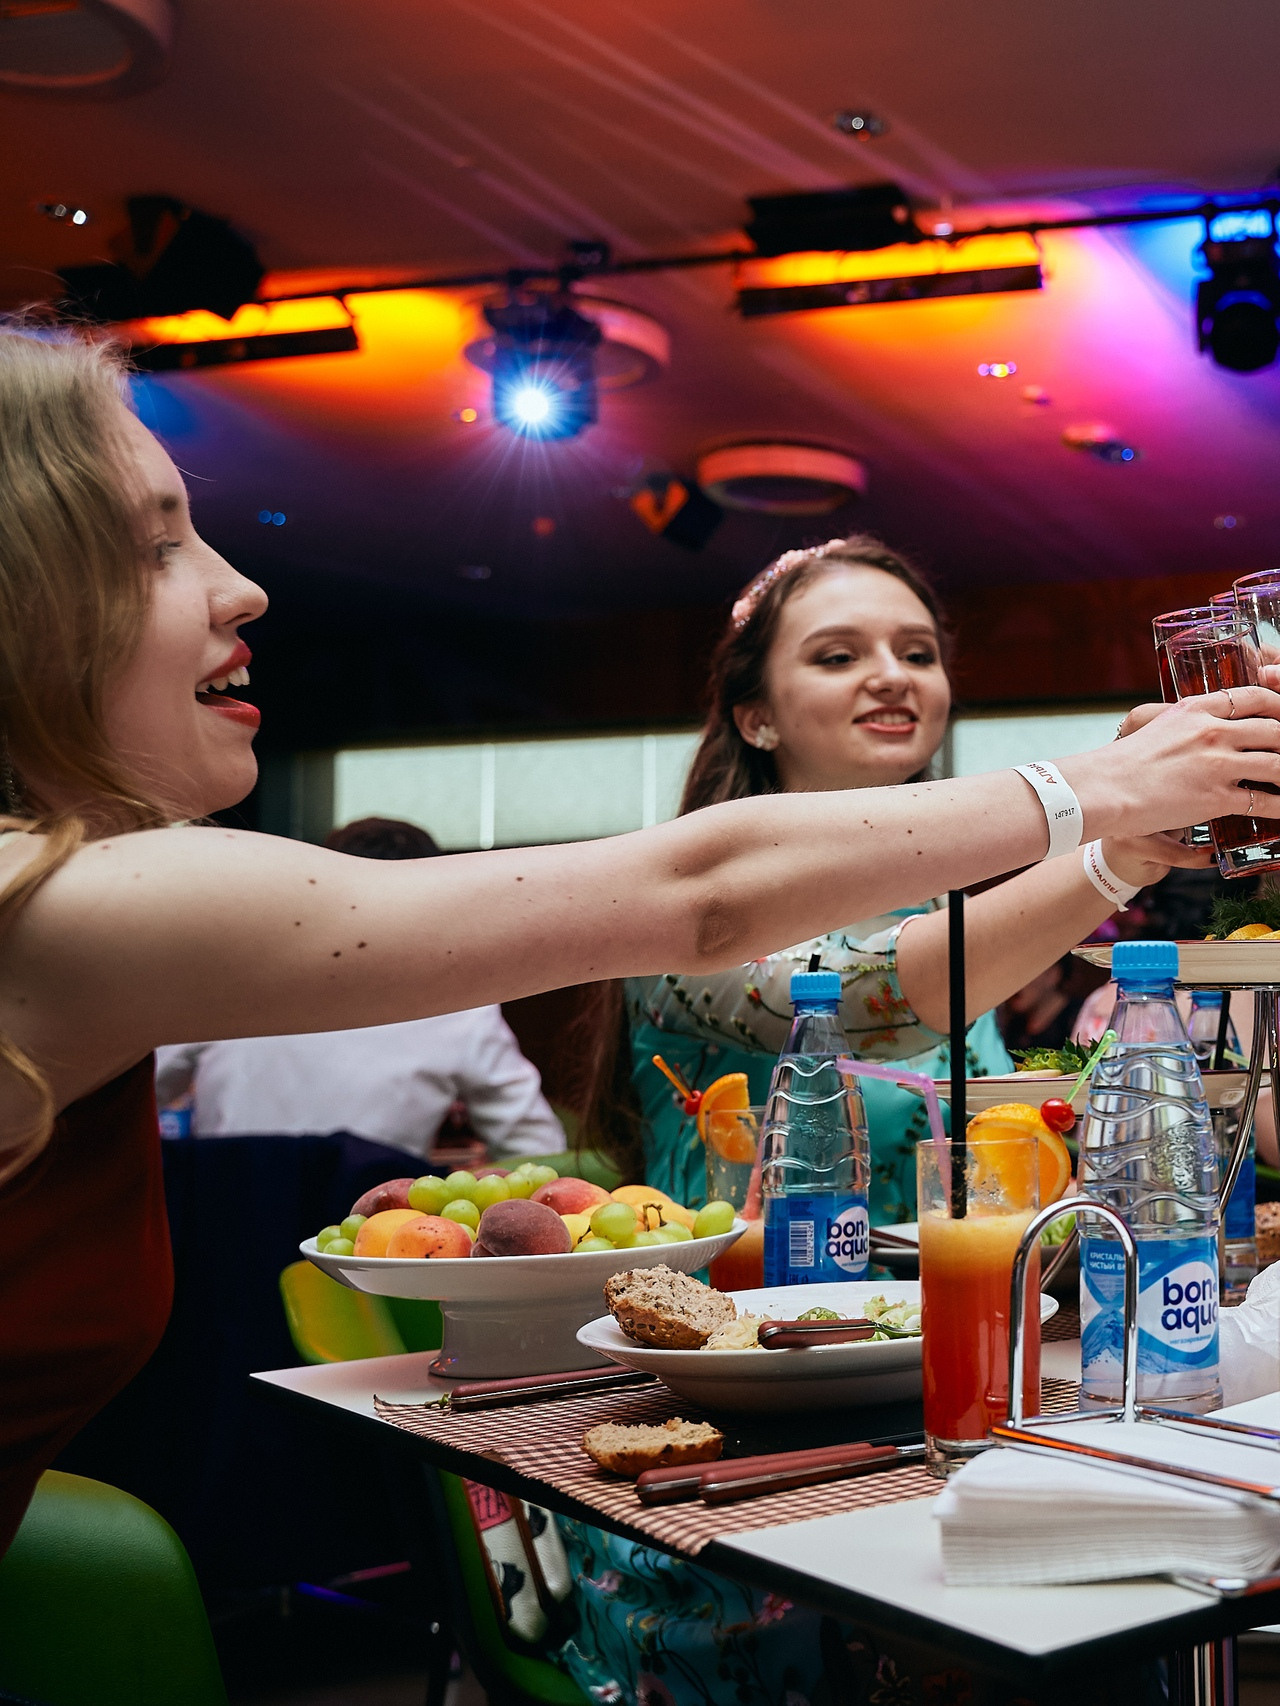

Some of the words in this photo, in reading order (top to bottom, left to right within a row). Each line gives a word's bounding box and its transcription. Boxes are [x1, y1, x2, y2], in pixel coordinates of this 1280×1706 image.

[1055, 807, 1075, 820] 147917
[826, 1217, 864, 1239] bon
[1163, 1276, 1213, 1306] bon
